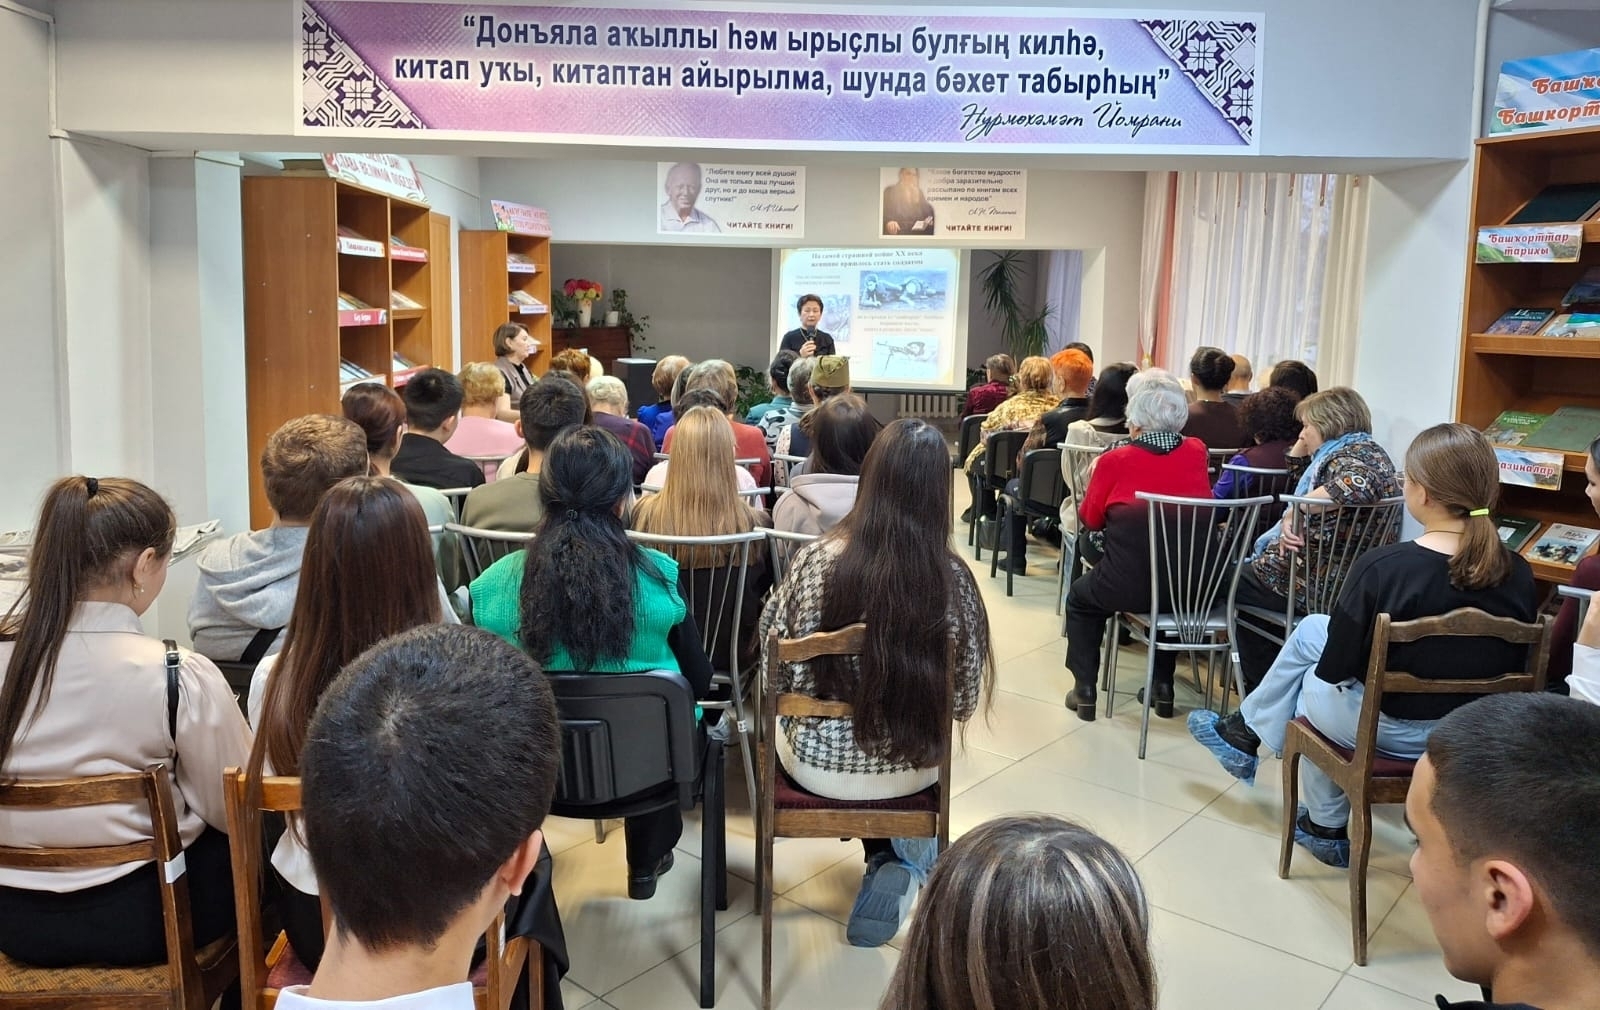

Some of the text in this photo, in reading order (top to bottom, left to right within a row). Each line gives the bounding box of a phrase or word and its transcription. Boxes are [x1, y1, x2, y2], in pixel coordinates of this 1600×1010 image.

[464, 15, 597, 48] “Донъяла
[608, 25, 718, 50] аҡыллы
[728, 22, 777, 51] һәм
[788, 31, 902, 59] ырыҫлы
[1019, 28, 1104, 61] килһә,
[395, 58, 1170, 101] китап уҡы, китаптан айырылма, шунда бәхет табырһың”
[727, 221, 762, 229] ЧИТАЙТЕ
[946, 223, 980, 231] ЧИТАЙТЕ
[1504, 246, 1549, 257] тарихы
[1500, 462, 1555, 477] азиналар
